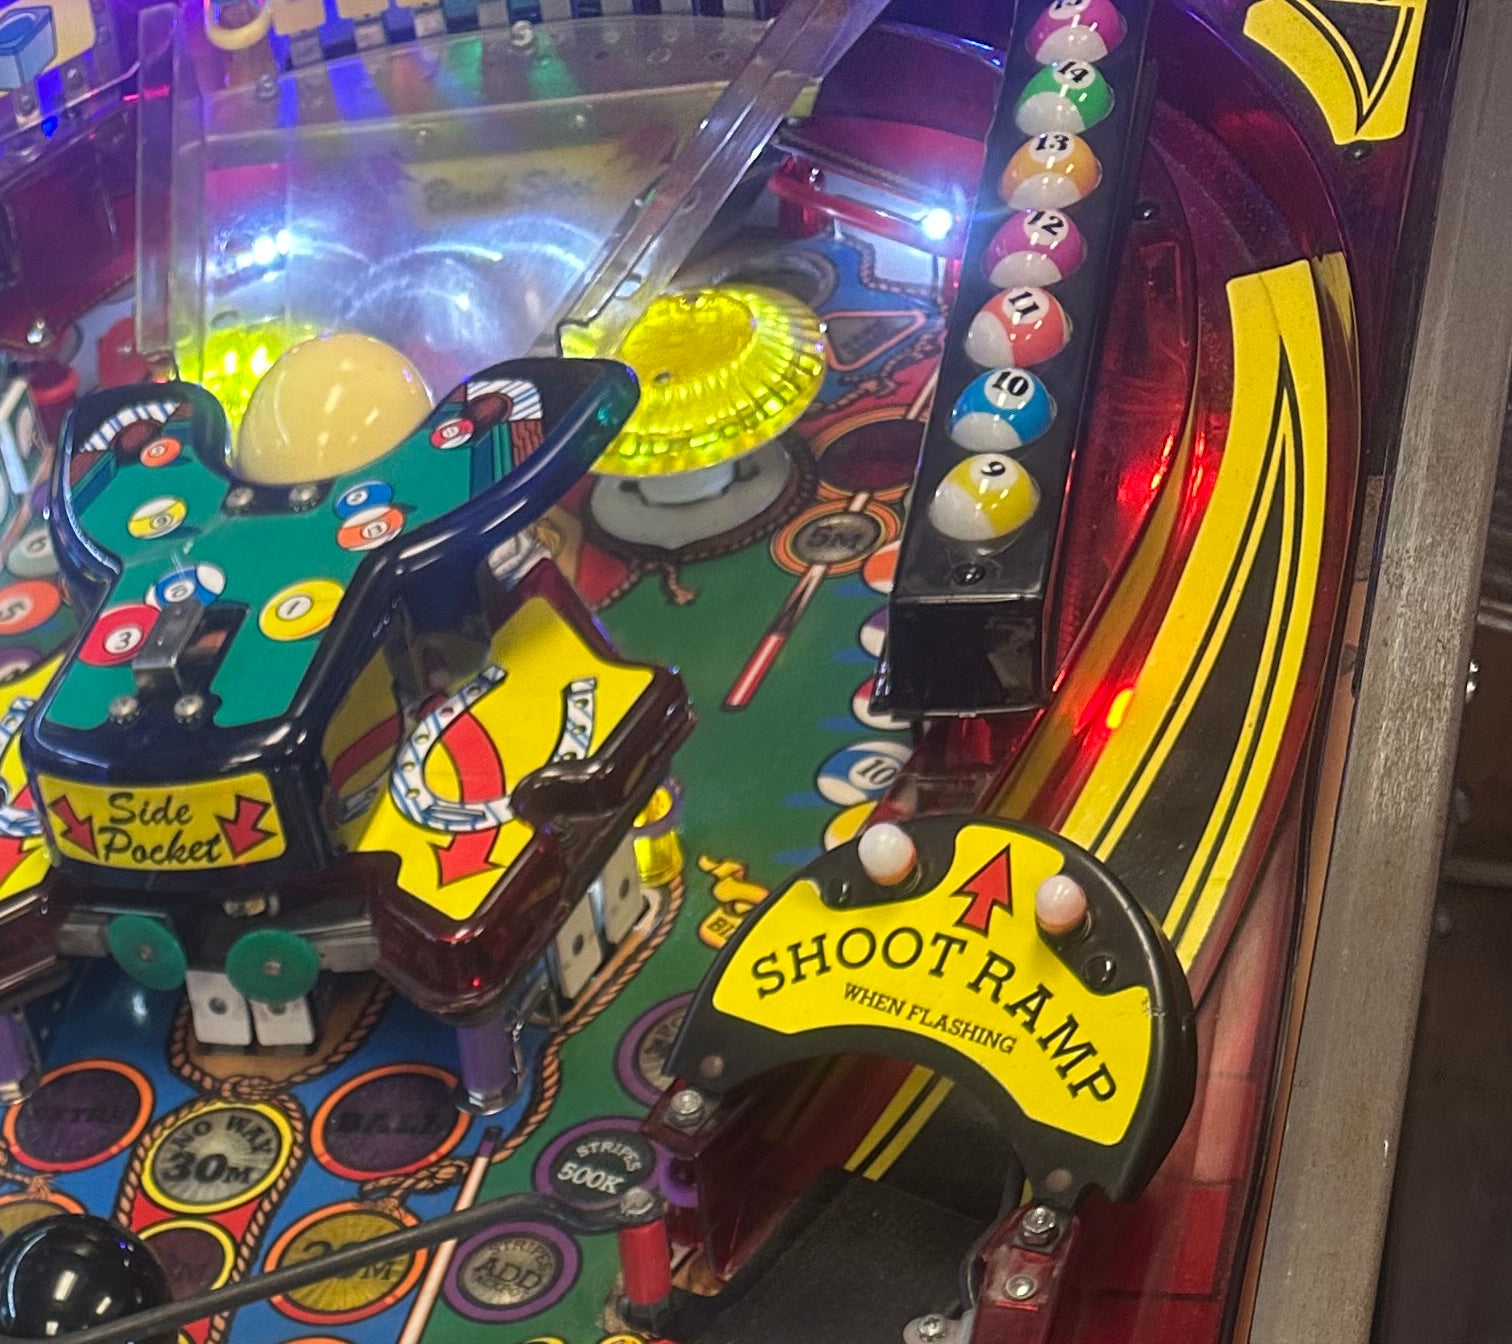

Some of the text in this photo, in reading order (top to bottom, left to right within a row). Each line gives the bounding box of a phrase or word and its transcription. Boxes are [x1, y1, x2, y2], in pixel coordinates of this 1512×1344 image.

[1056, 63, 1090, 84] 14
[1035, 133, 1069, 152] 13
[1028, 209, 1065, 236] 12
[995, 371, 1029, 398] 10
[857, 759, 899, 786] 10
[107, 791, 193, 826] Side
[98, 826, 222, 864] Pocket
[750, 926, 1118, 1104] SHOOT RAMP
[843, 981, 1018, 1056] WHEN FLASHING
[171, 1113, 274, 1156] NO WAY
[171, 1152, 252, 1187] 30M
[576, 1139, 643, 1172] STRIPES
[557, 1161, 625, 1194] 500K
